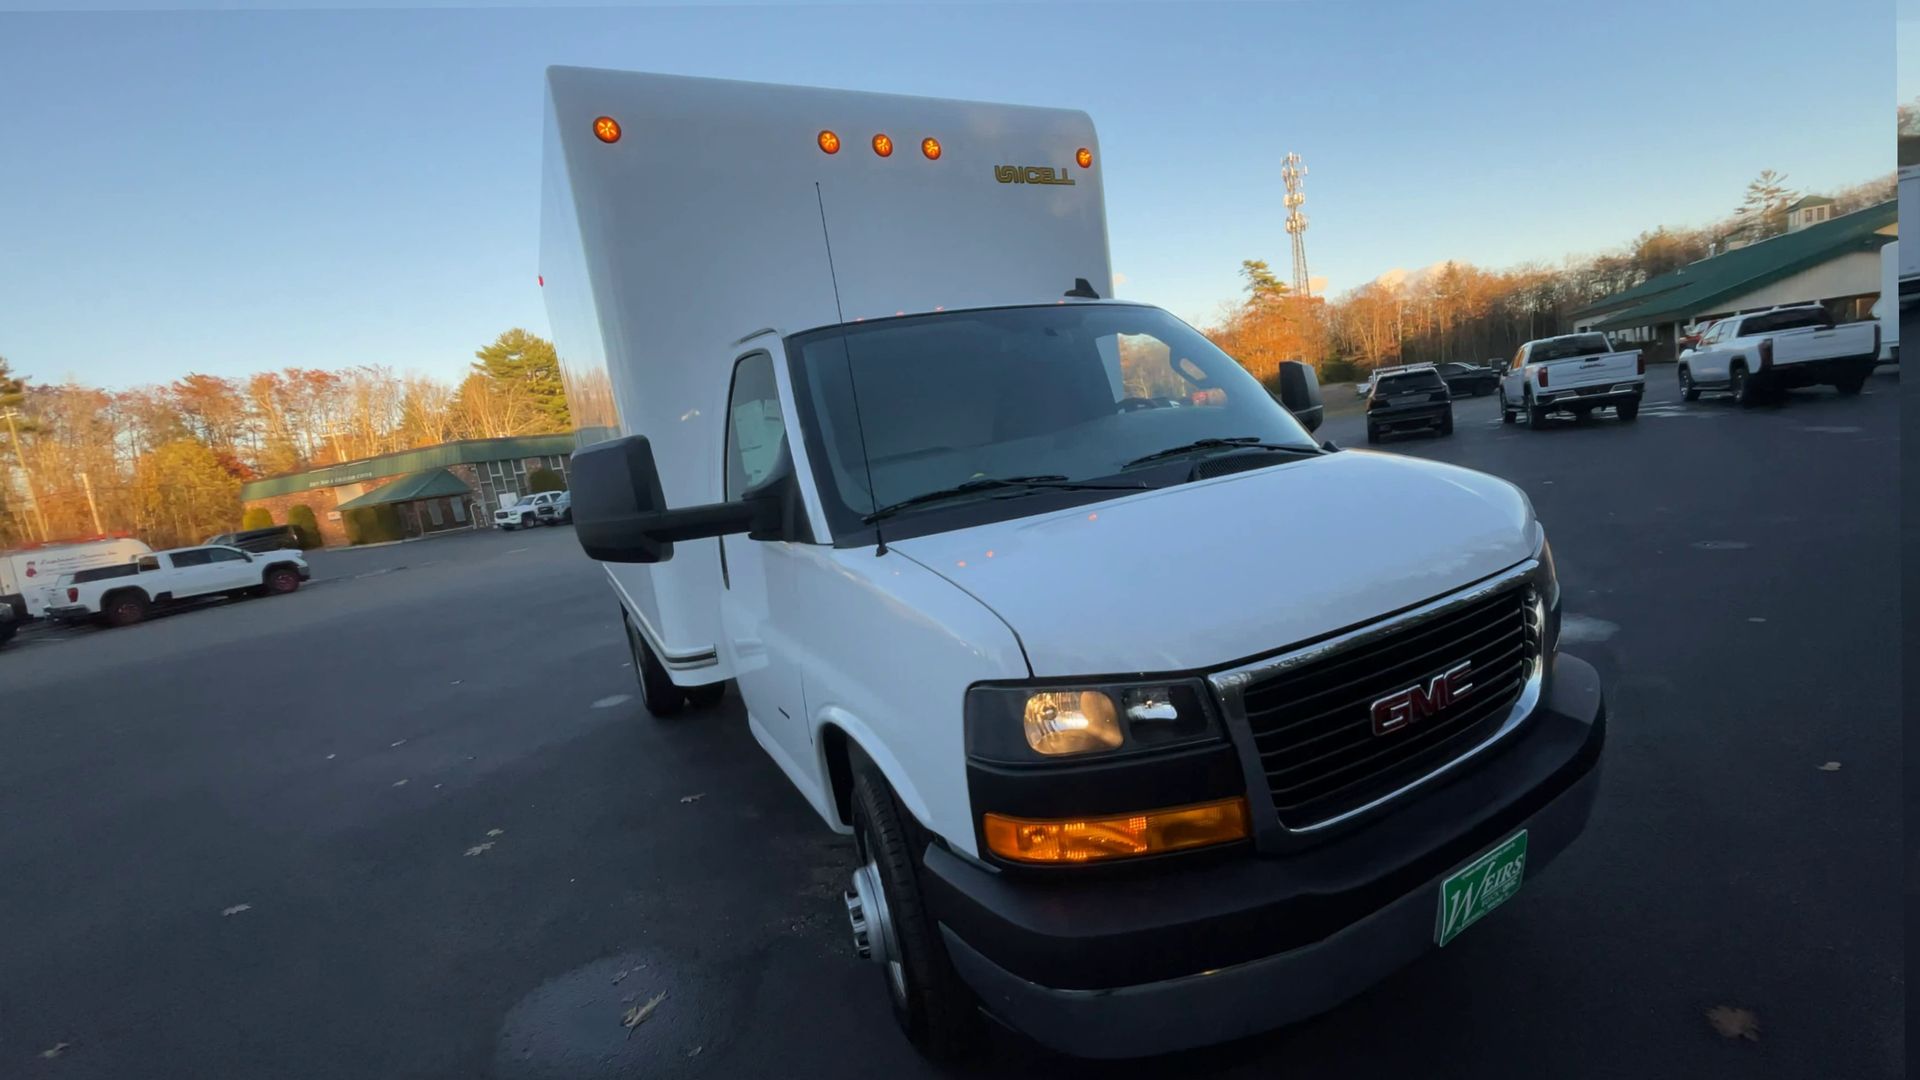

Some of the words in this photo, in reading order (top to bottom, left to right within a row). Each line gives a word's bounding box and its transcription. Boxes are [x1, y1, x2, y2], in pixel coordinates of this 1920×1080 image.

[994, 165, 1076, 185] UNICELL
[1370, 660, 1473, 736] GMC
[1445, 854, 1524, 936] WEIRS
